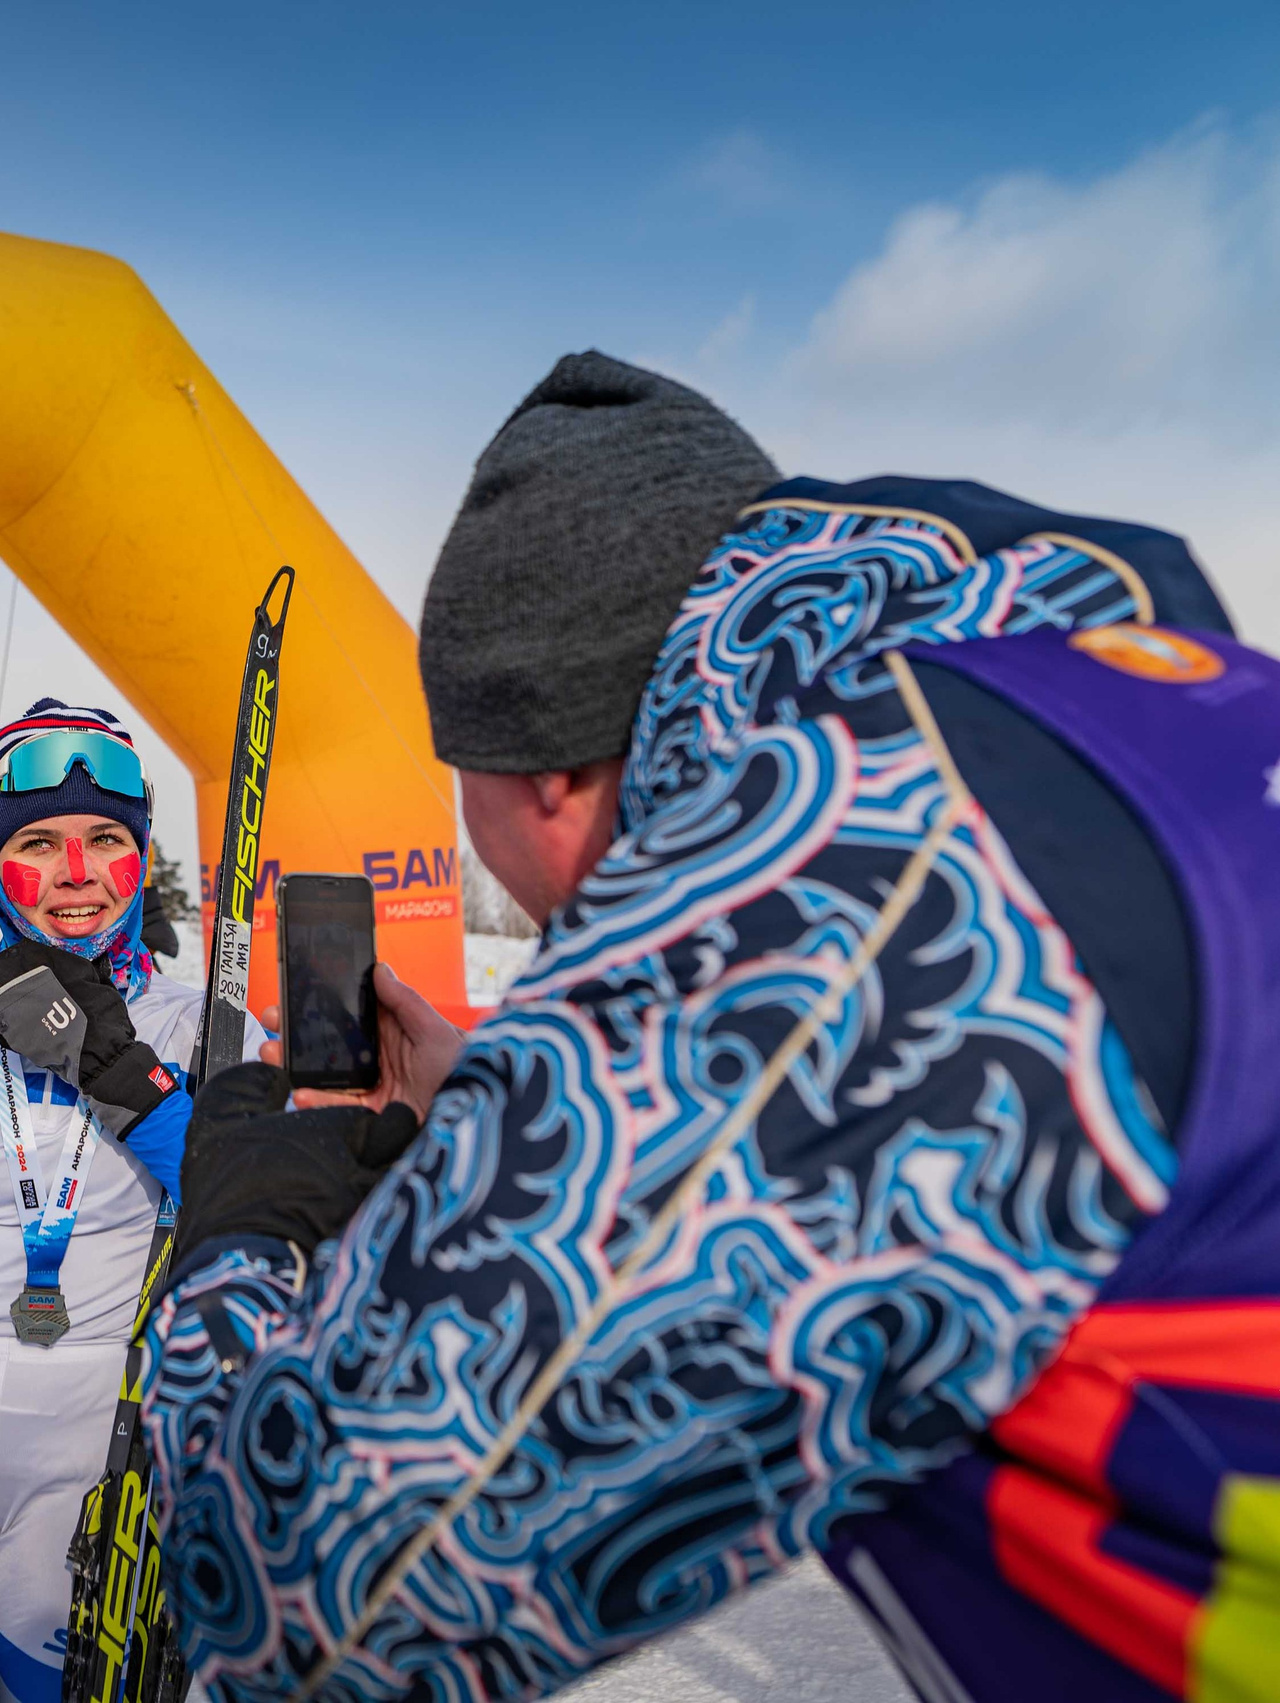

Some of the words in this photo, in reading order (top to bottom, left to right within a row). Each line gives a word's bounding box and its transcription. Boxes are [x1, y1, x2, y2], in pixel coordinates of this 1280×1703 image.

[232, 668, 276, 930] FISCHER
[200, 859, 280, 903] БМ
[363, 847, 457, 891] БАМ
[221, 922, 238, 976] ГАЛУЗА
[219, 979, 246, 1002] 2024
[0, 1046, 13, 1083] РСКИЙ
[6, 1084, 21, 1139] МАРАФОН
[16, 1144, 27, 1172] 2024
[56, 1176, 72, 1208] БАМ
[71, 1107, 93, 1172] АНГАРСКИЙ
